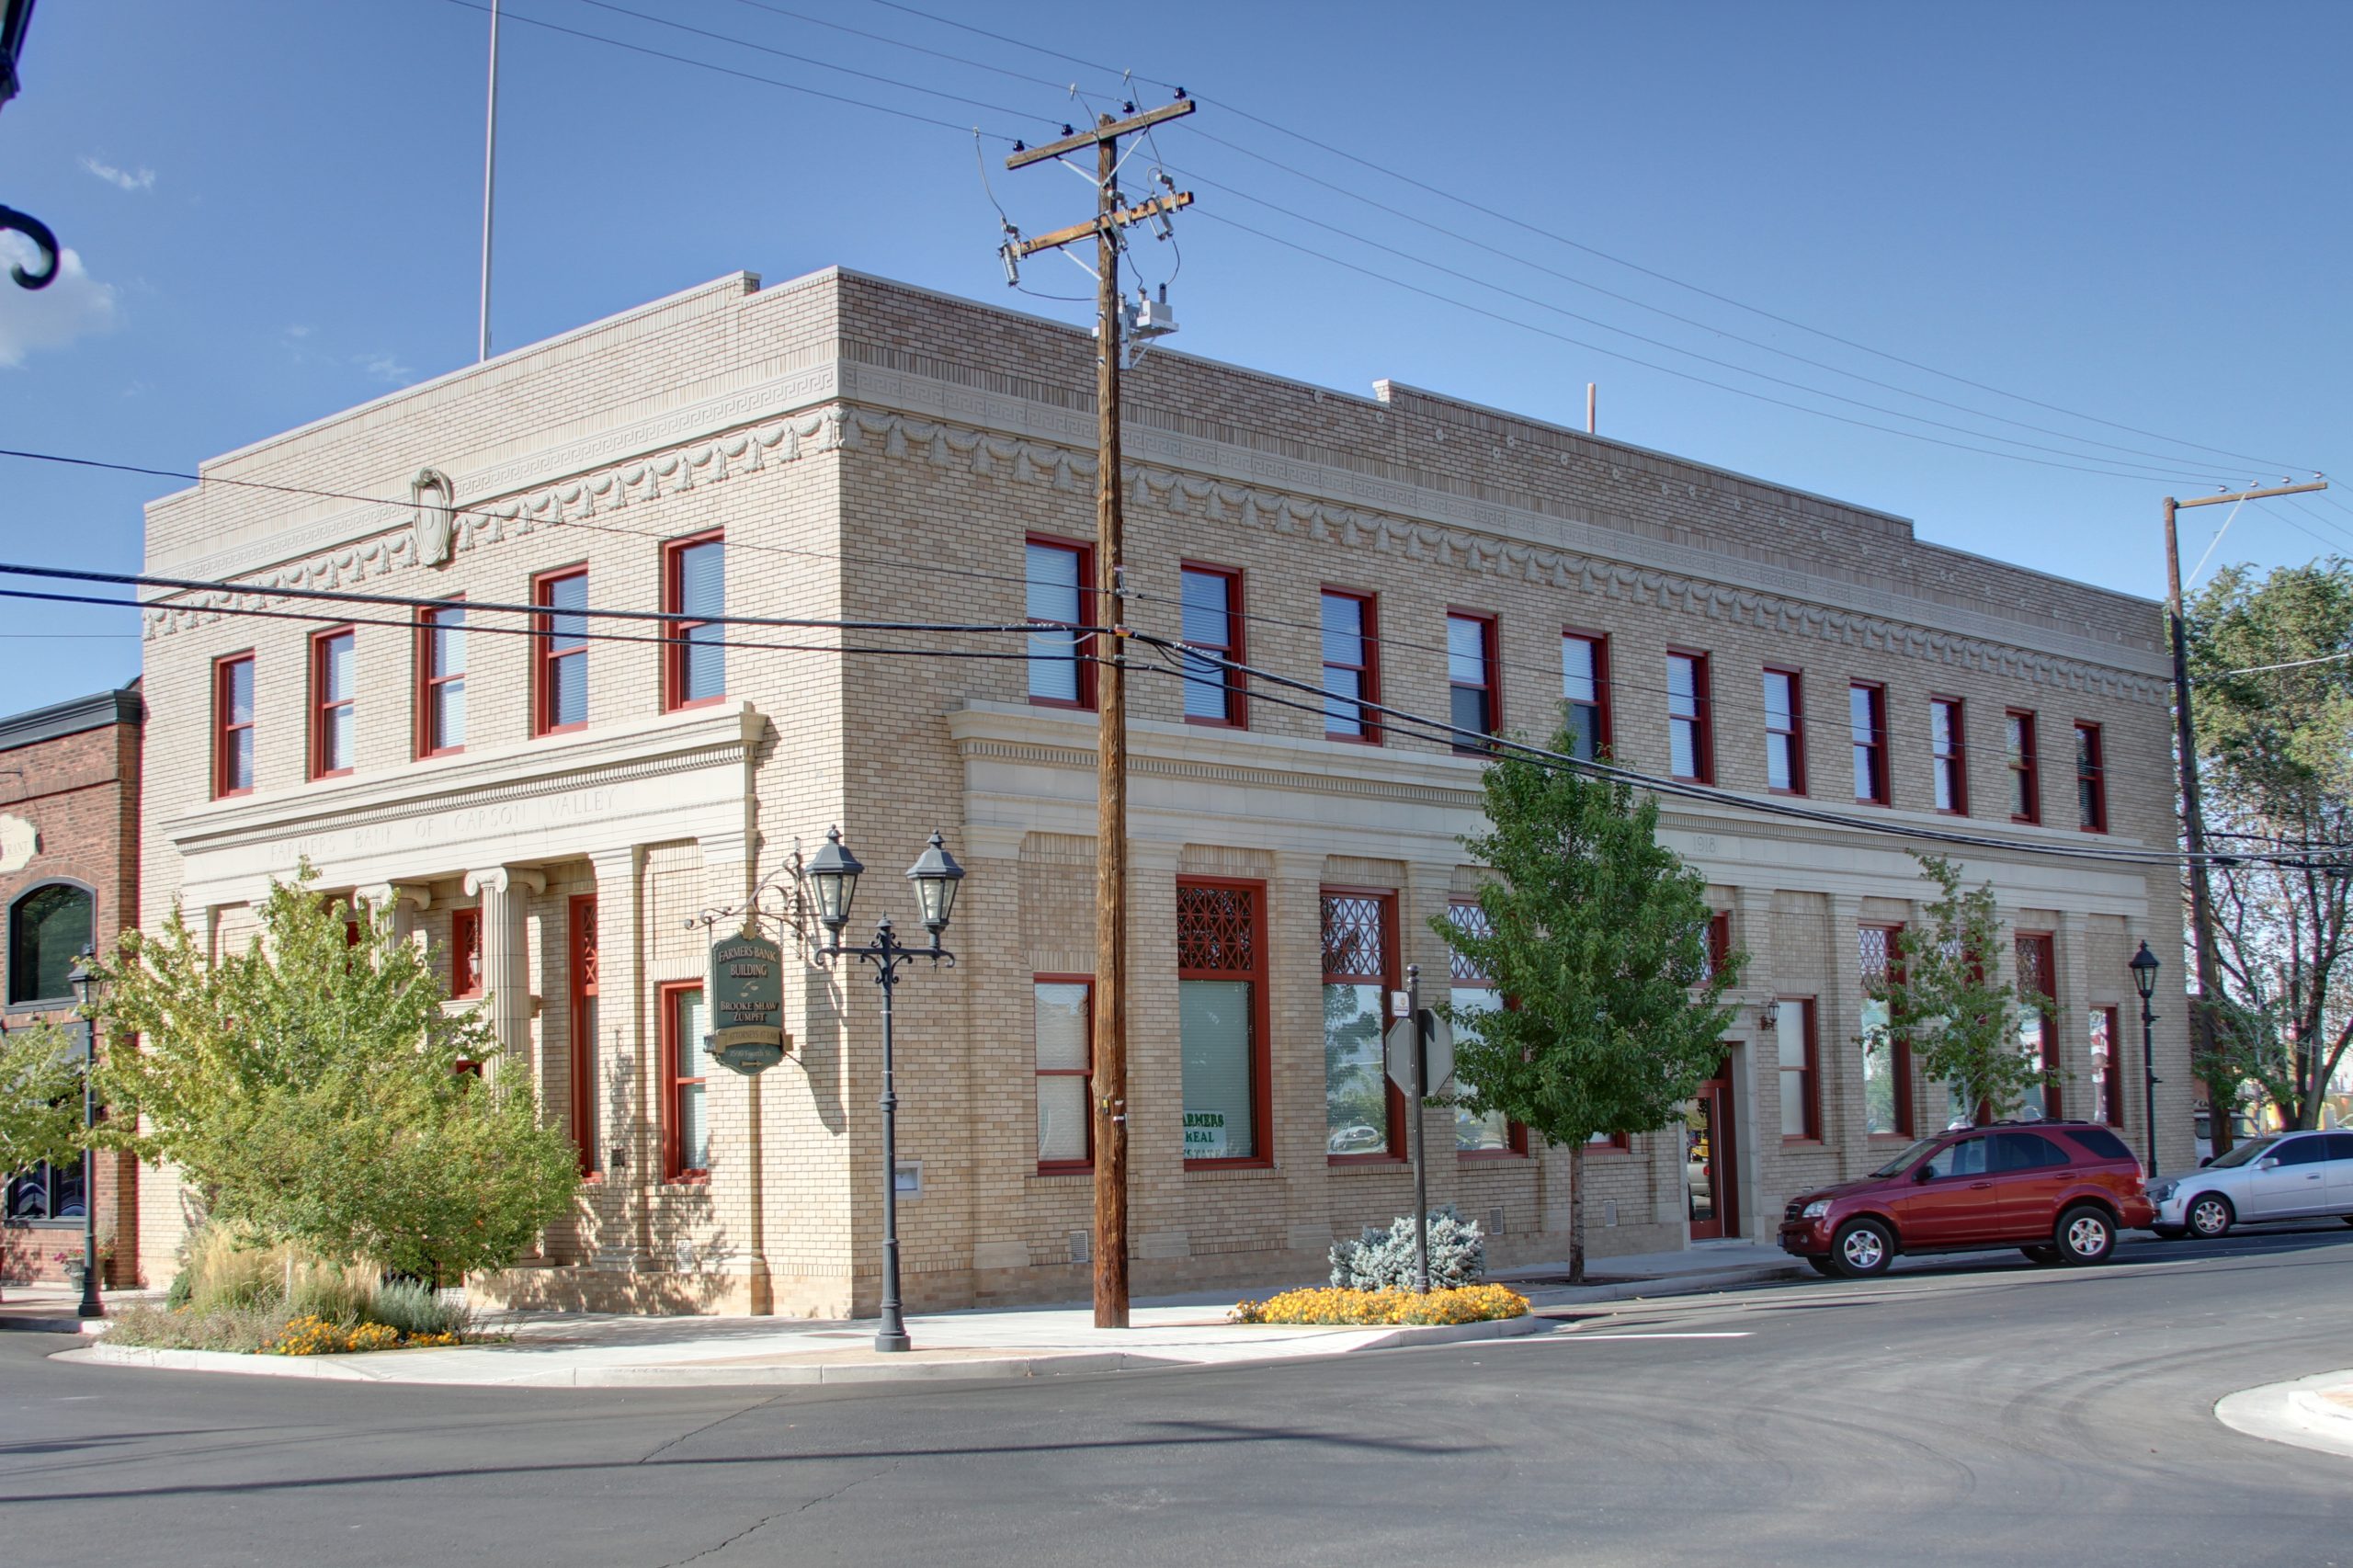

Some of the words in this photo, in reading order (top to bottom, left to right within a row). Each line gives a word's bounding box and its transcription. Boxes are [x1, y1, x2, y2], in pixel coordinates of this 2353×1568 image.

[271, 835, 336, 862] FARMERS
[354, 825, 394, 849] BANK
[415, 818, 435, 839] OF
[454, 803, 527, 833] CARSON
[549, 786, 619, 818] VALLEY
[1692, 836, 1716, 853] 1918
[719, 946, 753, 962] FARMERS
[755, 947, 777, 962] BANK
[730, 963, 767, 976] BUILDING
[721, 1000, 752, 1010] BROOKE
[754, 1000, 778, 1010] SHAW
[733, 1012, 766, 1022] ZUMPFT
[1186, 1131, 1214, 1142] REAL
